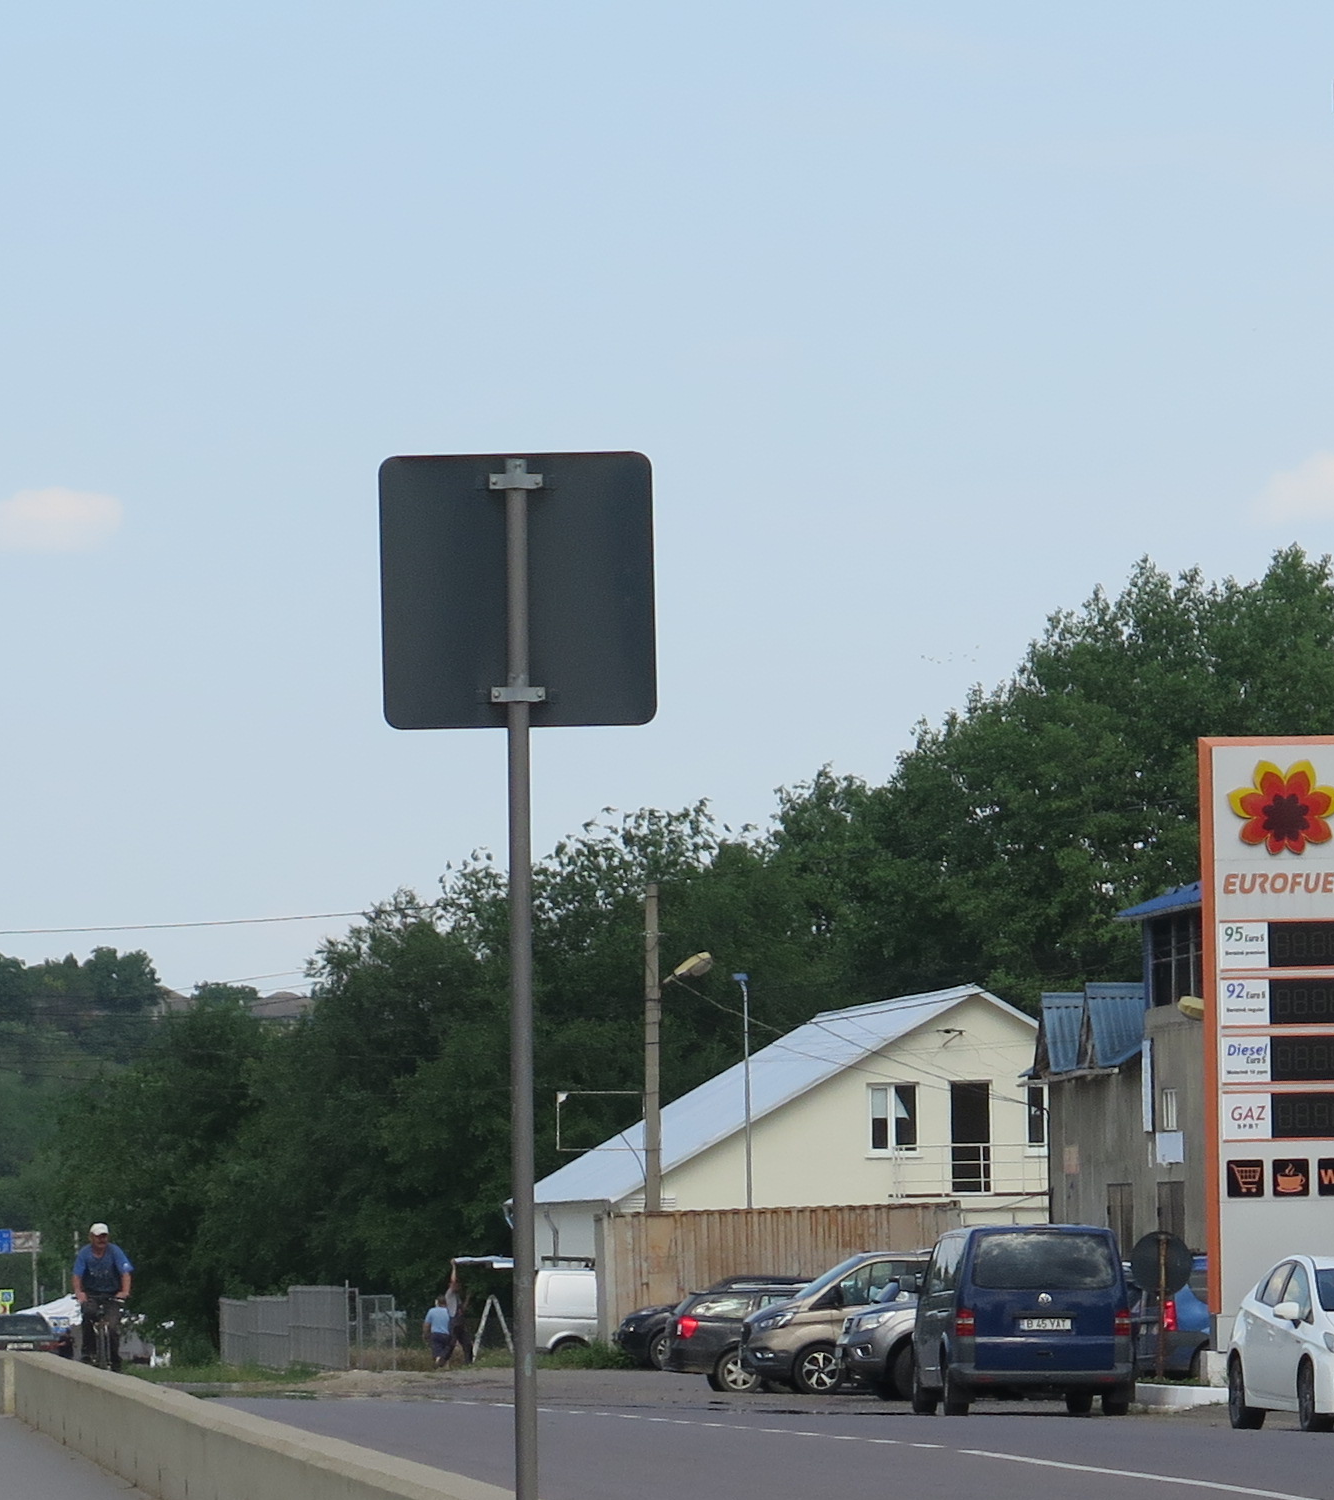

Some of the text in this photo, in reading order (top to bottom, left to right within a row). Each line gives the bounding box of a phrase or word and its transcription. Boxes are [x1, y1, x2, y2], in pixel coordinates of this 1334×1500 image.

[1224, 926, 1243, 942] 95
[1226, 983, 1245, 998] 92
[1227, 1043, 1268, 1056] Diesel
[1231, 1105, 1266, 1121] GAZ
[1036, 1319, 1047, 1328] 45
